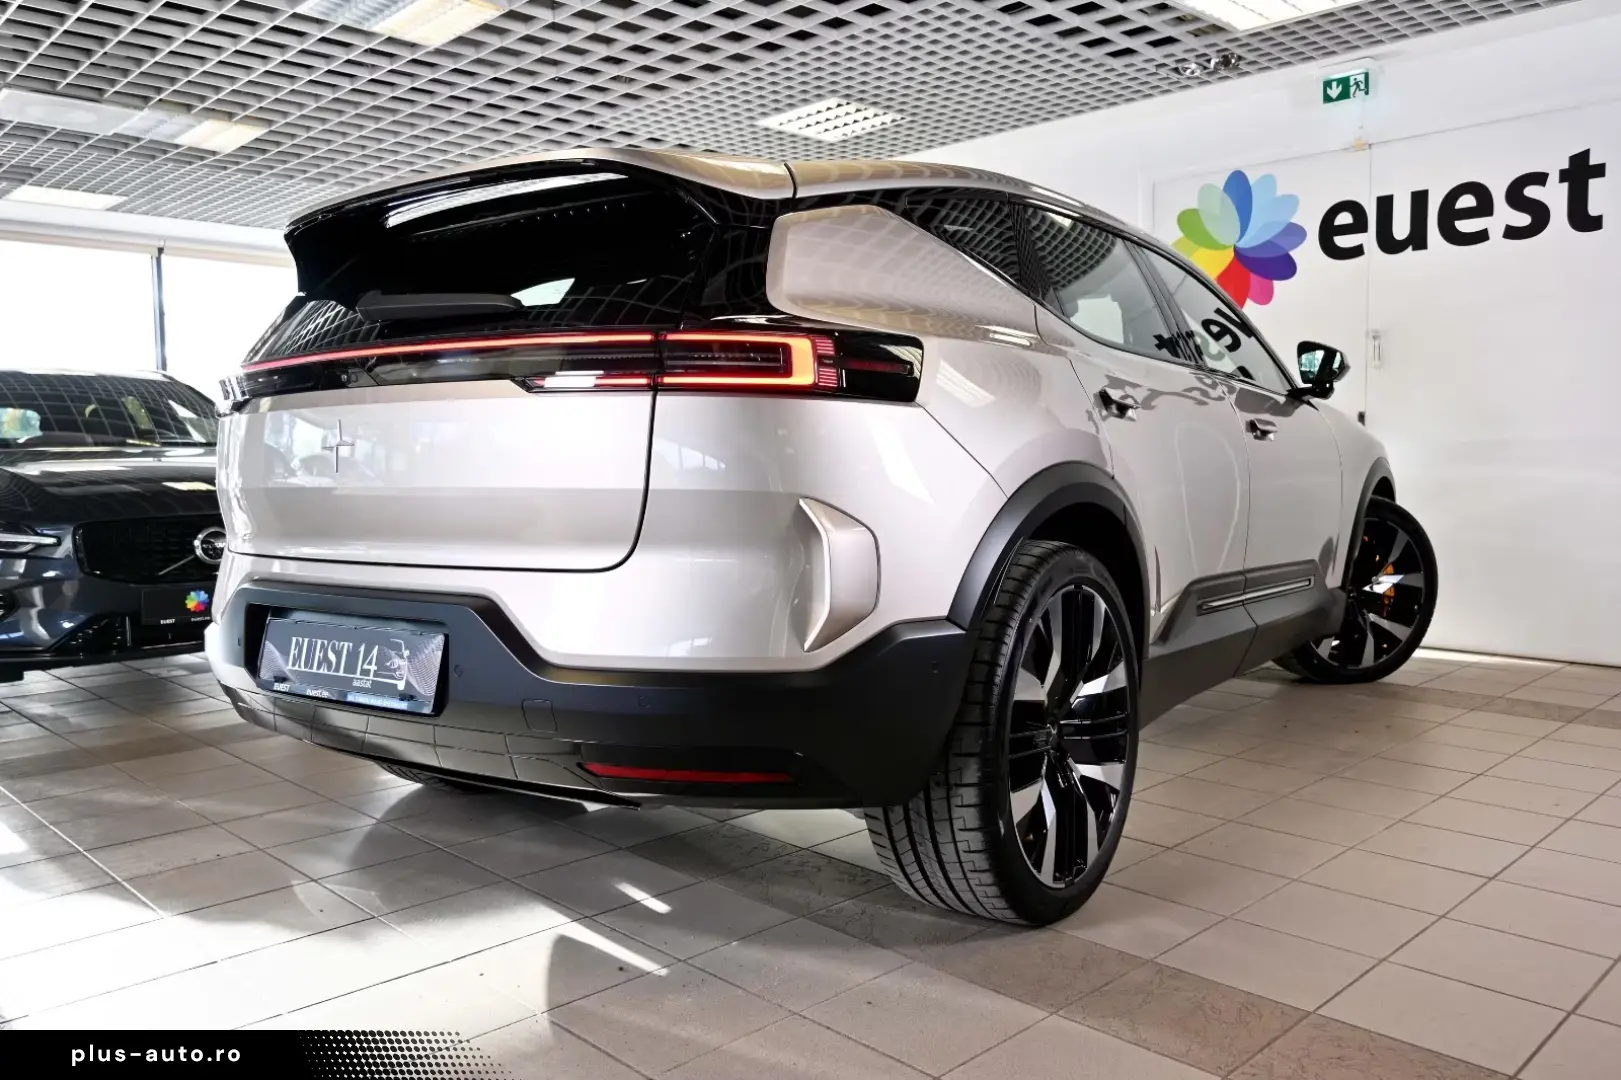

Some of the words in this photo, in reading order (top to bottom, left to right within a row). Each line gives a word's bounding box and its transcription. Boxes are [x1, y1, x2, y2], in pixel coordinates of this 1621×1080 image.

[1318, 148, 1606, 260] euest
[288, 637, 353, 674] EUEST
[356, 643, 379, 677] 14
[352, 678, 373, 689] aastat
